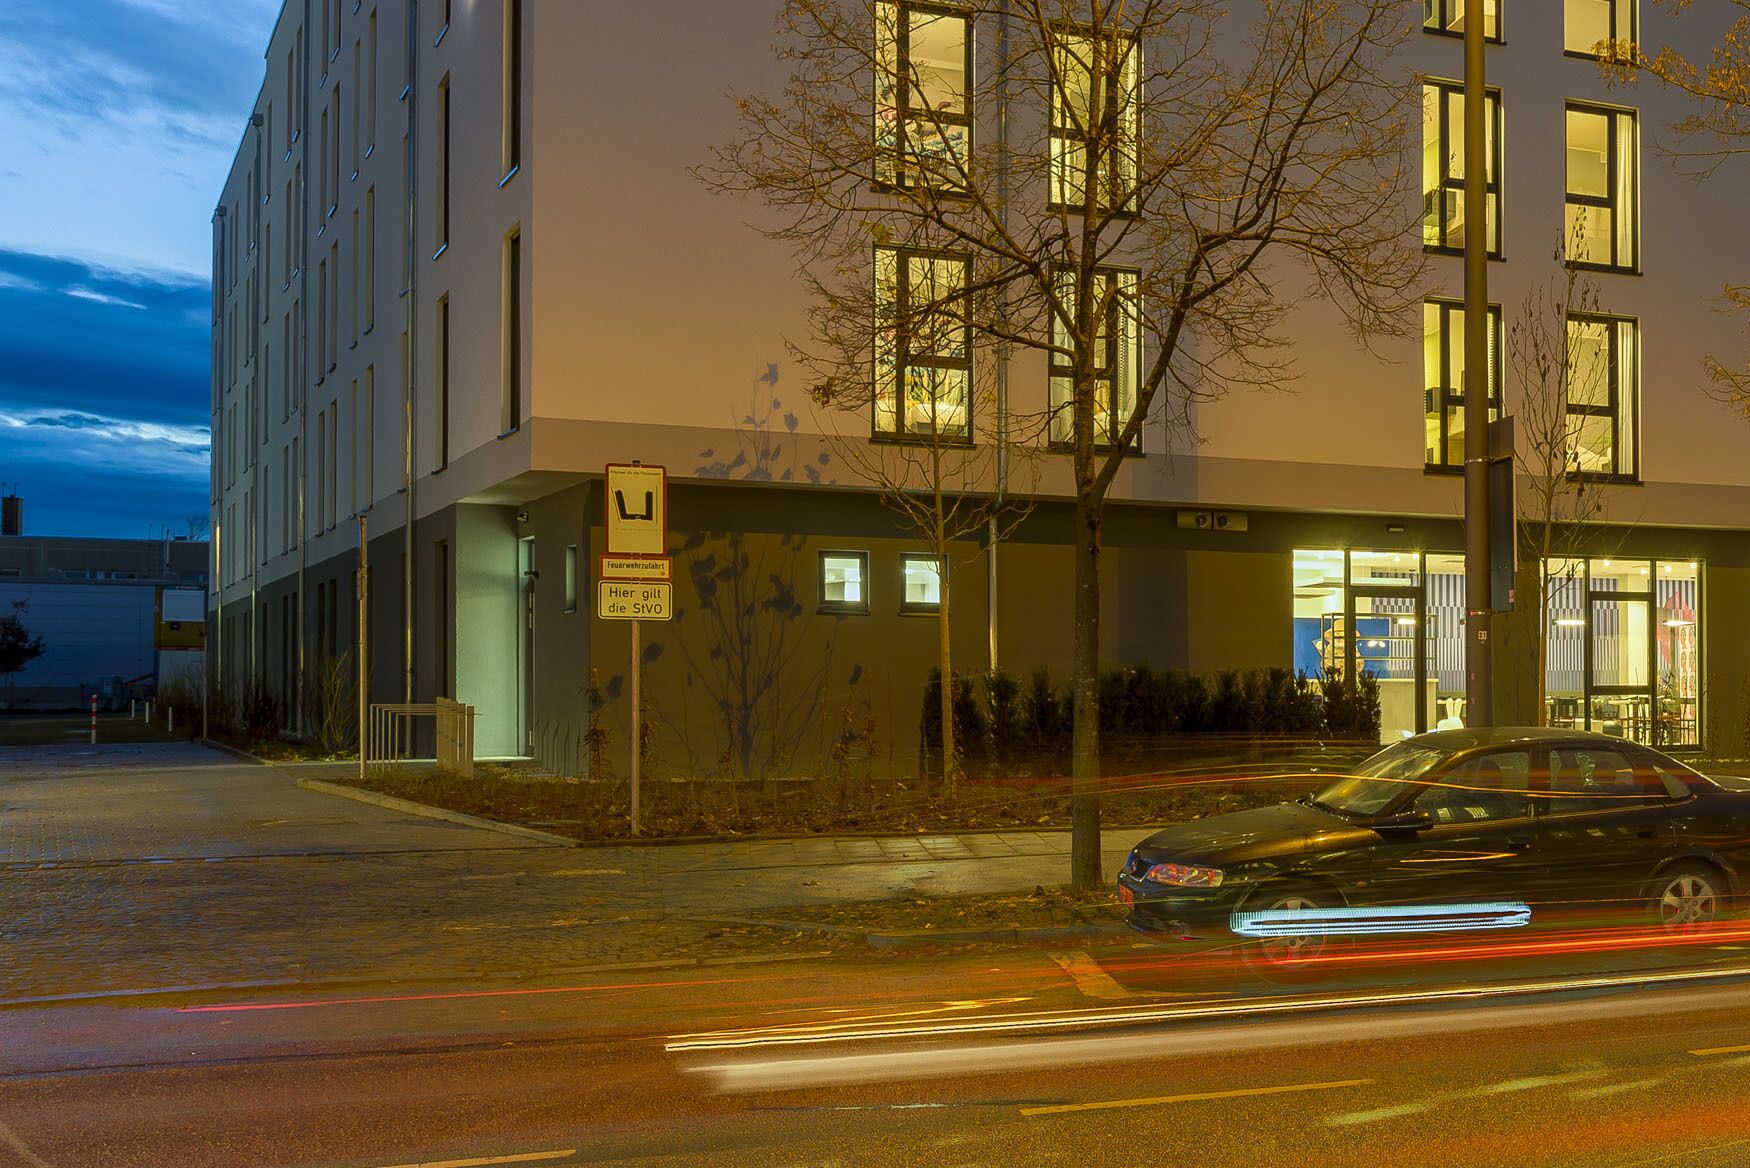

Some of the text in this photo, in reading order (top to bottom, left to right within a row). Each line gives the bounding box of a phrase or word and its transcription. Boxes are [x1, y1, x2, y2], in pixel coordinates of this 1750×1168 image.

[607, 561, 665, 570] Feuerwehrzufahrt
[609, 587, 662, 602] Hier gilt
[608, 602, 663, 615] die StVO
